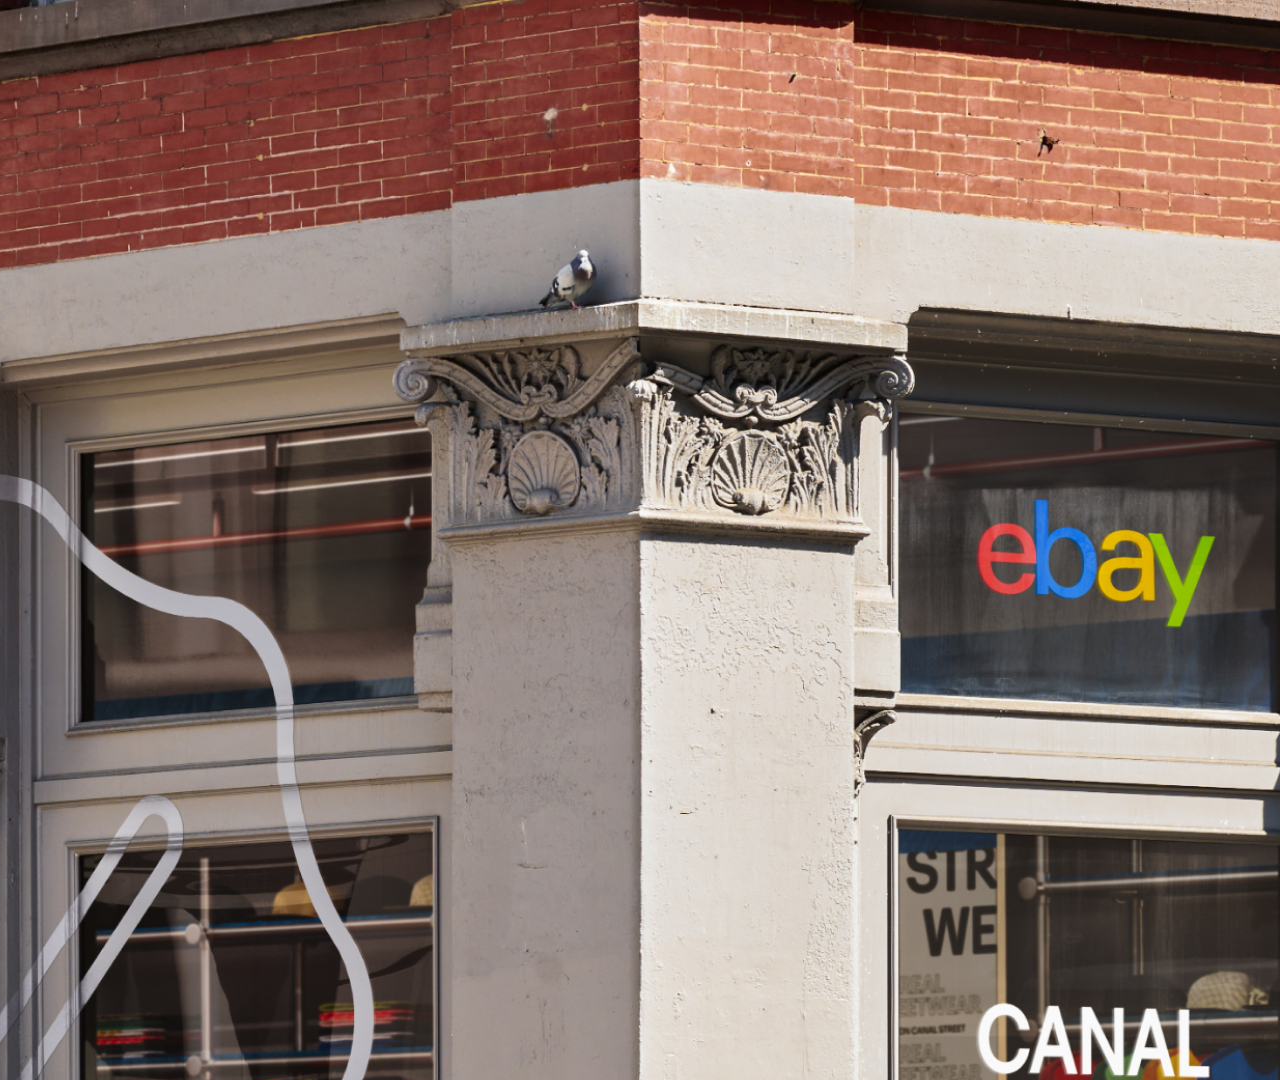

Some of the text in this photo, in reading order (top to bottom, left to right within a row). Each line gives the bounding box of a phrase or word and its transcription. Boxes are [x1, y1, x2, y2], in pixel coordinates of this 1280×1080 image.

[977, 498, 1216, 628] ebay
[911, 1024, 938, 1035] CANAL
[938, 1024, 966, 1034] STREET
[977, 1003, 1210, 1078] CANAL
